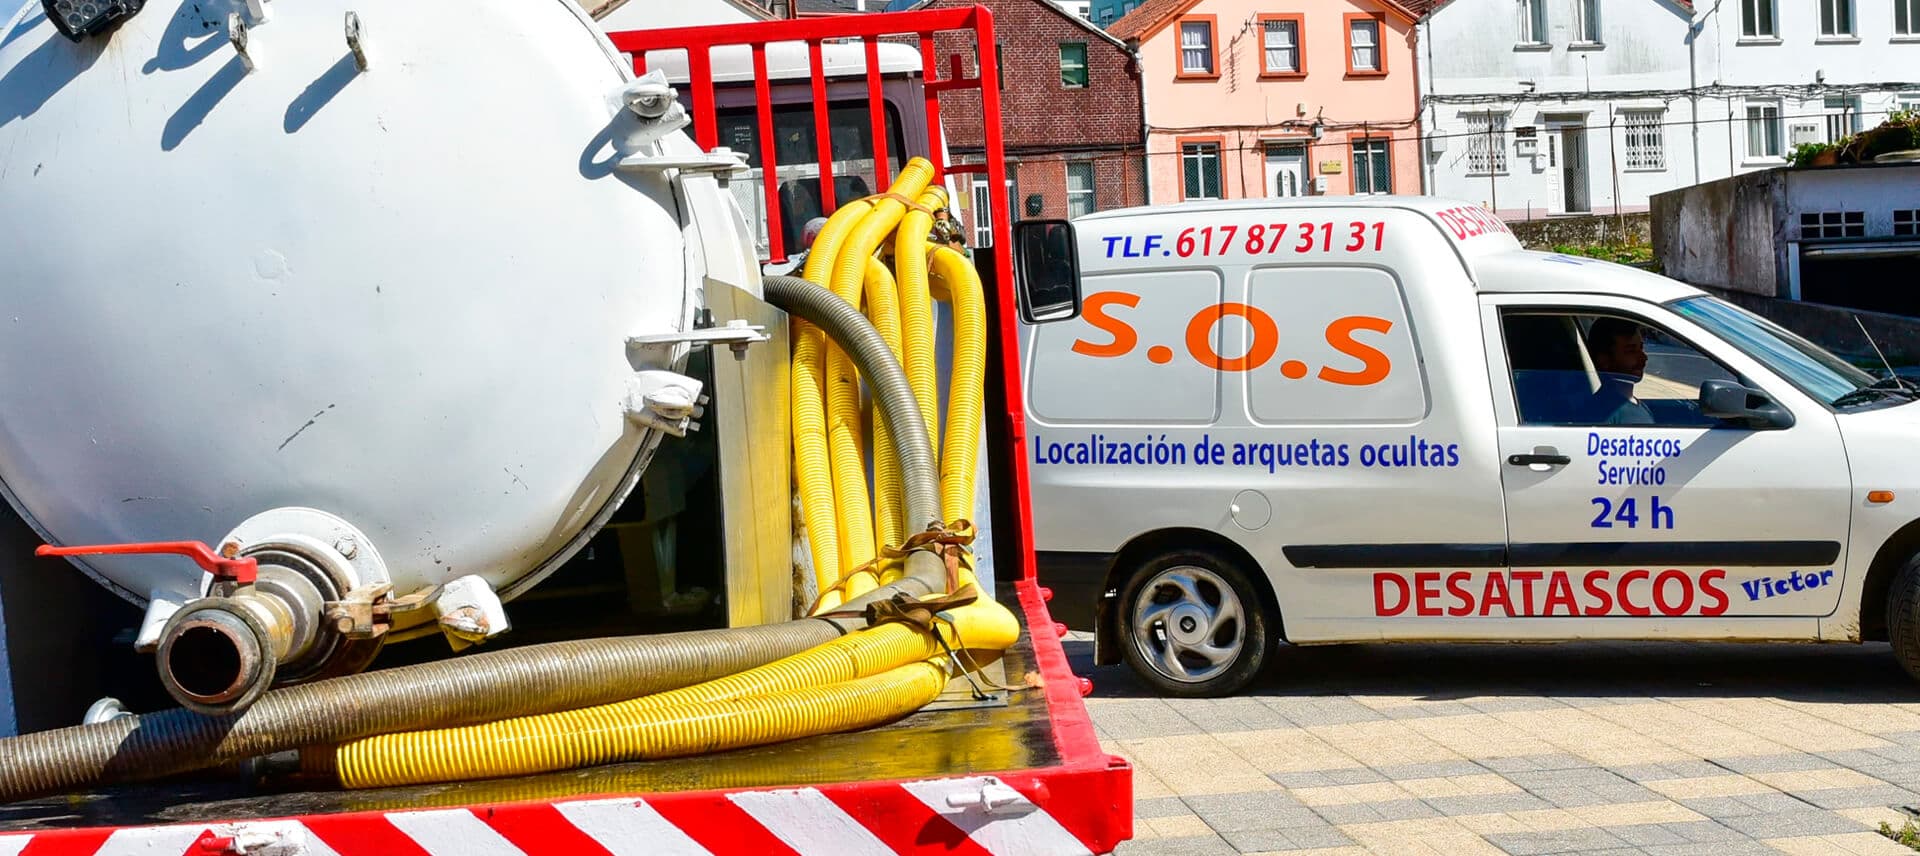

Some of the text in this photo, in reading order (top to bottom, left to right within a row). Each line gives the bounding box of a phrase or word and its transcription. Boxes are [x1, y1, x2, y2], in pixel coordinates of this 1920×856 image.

[1102, 221, 1385, 258] TLF. 617 87 31 31
[1072, 291, 1393, 386] S.O.S
[1035, 433, 1460, 474] Localización de arquetas ocultas
[1587, 432, 1682, 458] Desatascos
[1598, 460, 1666, 486] Servicio
[1591, 495, 1674, 529] 24 h
[1373, 568, 1730, 618] DESATASCOS
